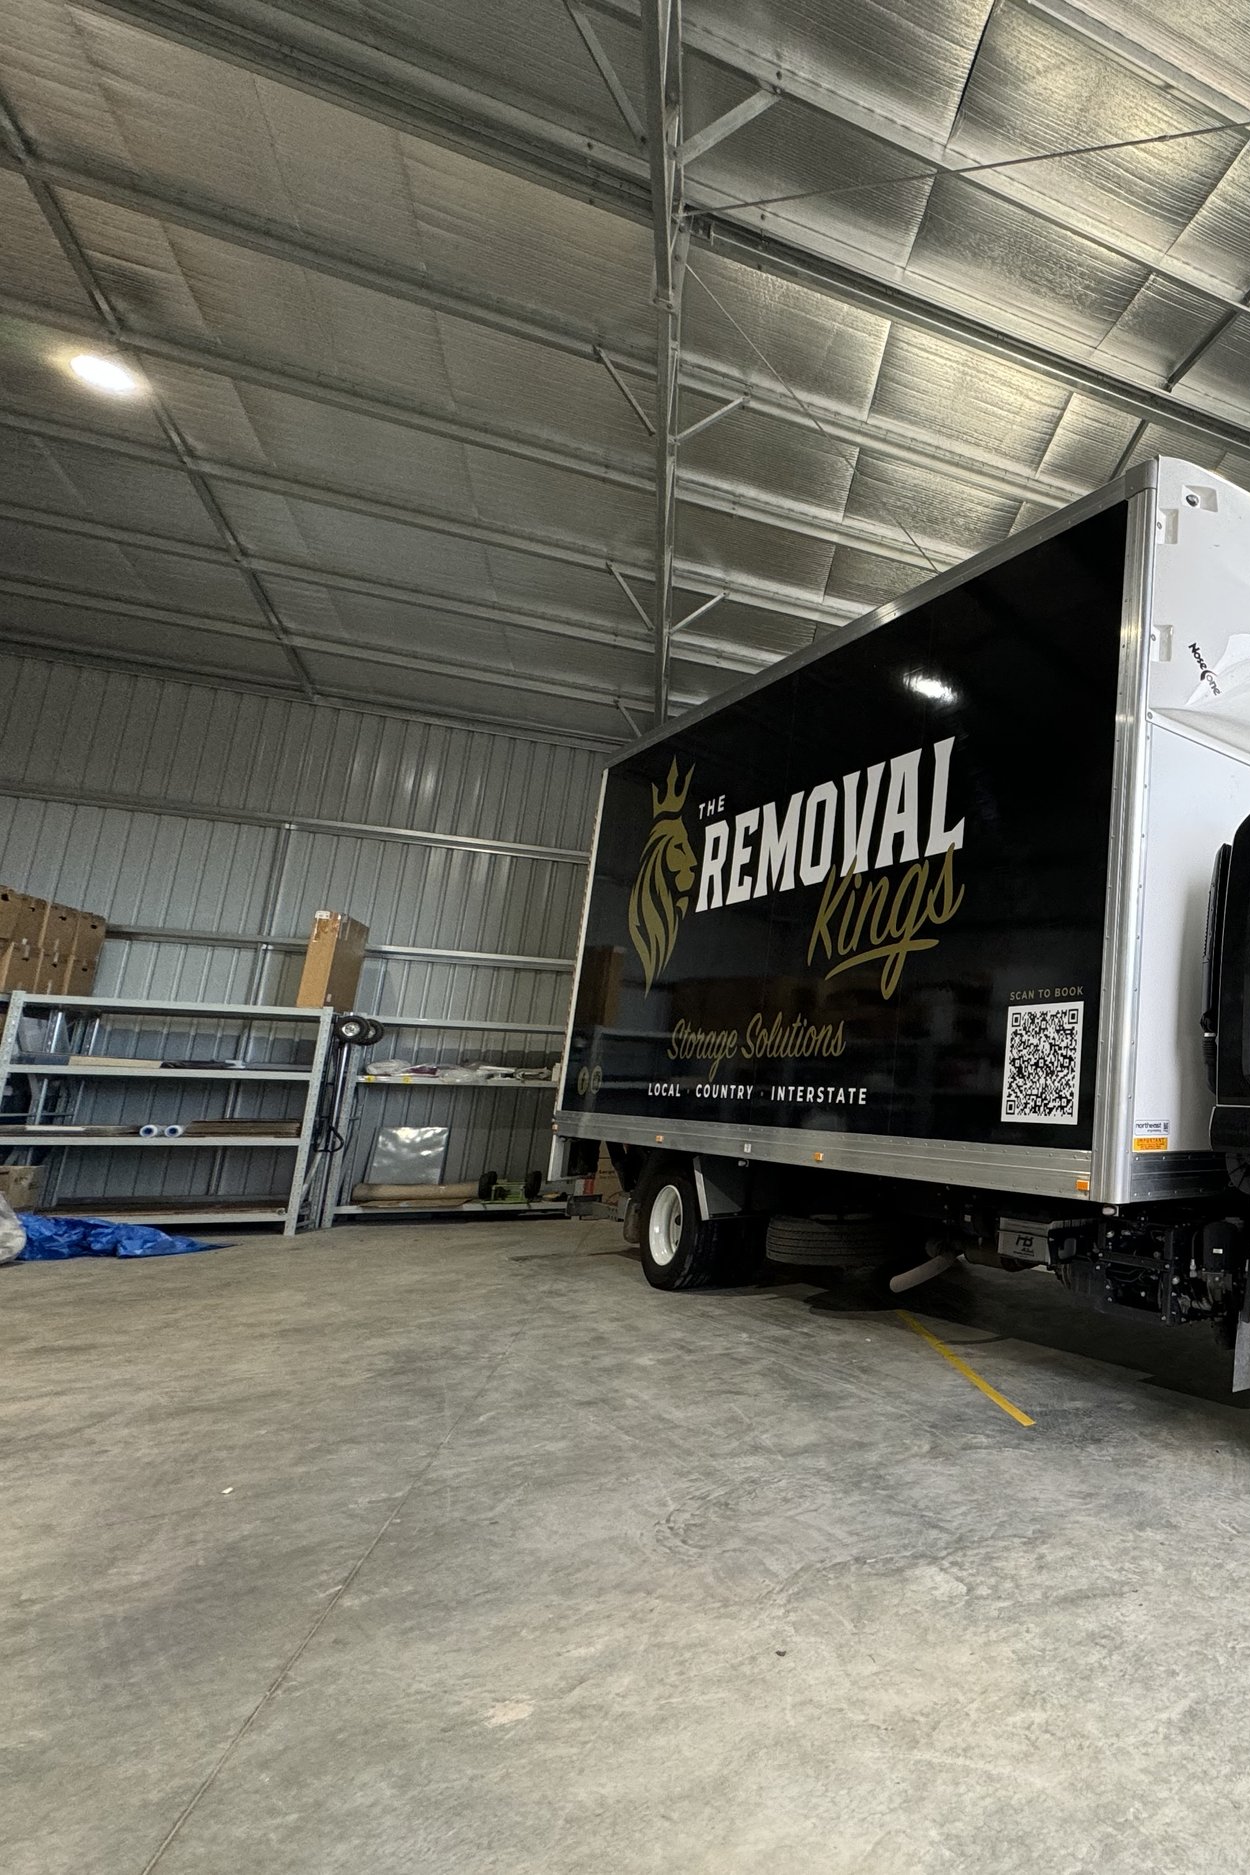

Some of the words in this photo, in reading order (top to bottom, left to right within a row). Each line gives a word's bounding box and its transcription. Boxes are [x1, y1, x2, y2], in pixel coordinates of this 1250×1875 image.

[695, 736, 966, 914] REMOVAL
[699, 794, 726, 820] THE
[807, 842, 966, 1000] Kings
[1009, 989, 1035, 1001] SCAN
[1038, 988, 1051, 998] TO
[1054, 986, 1084, 998] BOOK
[667, 1018, 738, 1082] Storage
[741, 1011, 847, 1058] Solutions
[647, 1083, 682, 1097] LOCAL
[695, 1084, 754, 1100] COUNTRY
[770, 1086, 868, 1105] INTERSTATE
